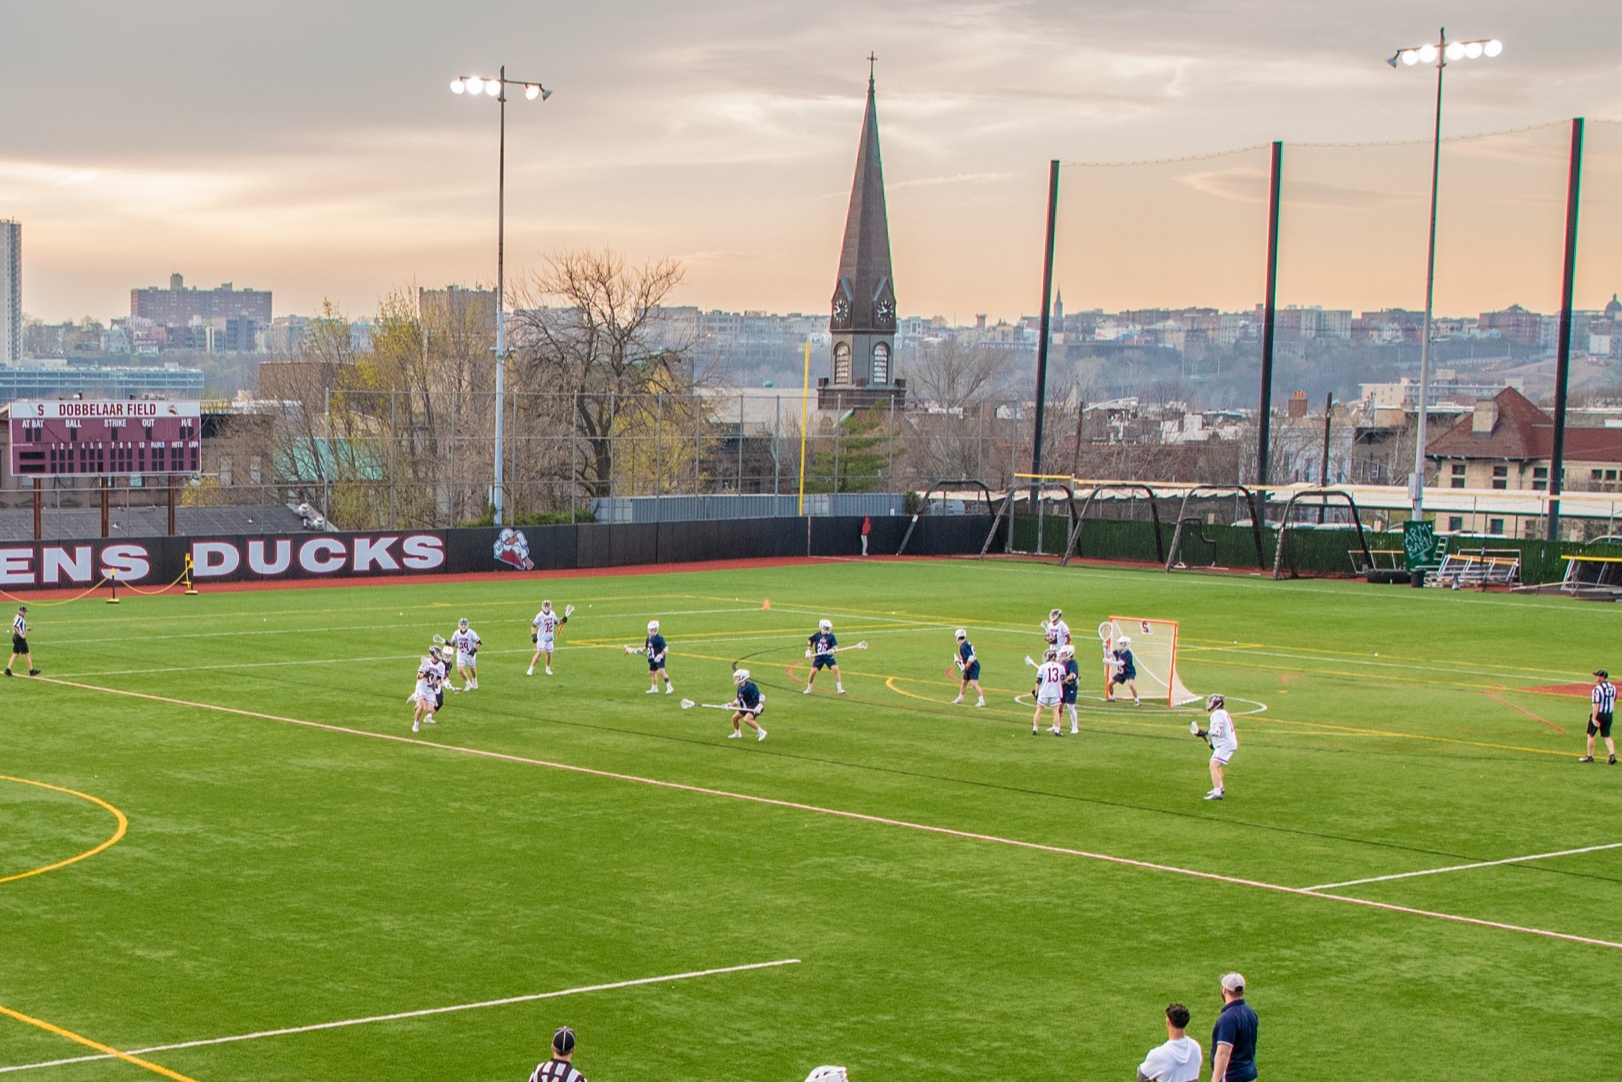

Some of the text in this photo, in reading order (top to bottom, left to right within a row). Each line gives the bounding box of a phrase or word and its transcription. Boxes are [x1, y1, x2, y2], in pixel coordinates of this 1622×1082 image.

[38, 403, 156, 416] S DOBBELAAR FIELD
[22, 419, 44, 428] AT BAT
[66, 419, 81, 428] BALL
[104, 419, 127, 428] STRIKE
[142, 419, 155, 427] OUT
[192, 534, 445, 578] DUCKS
[1047, 667, 1059, 683] 13
